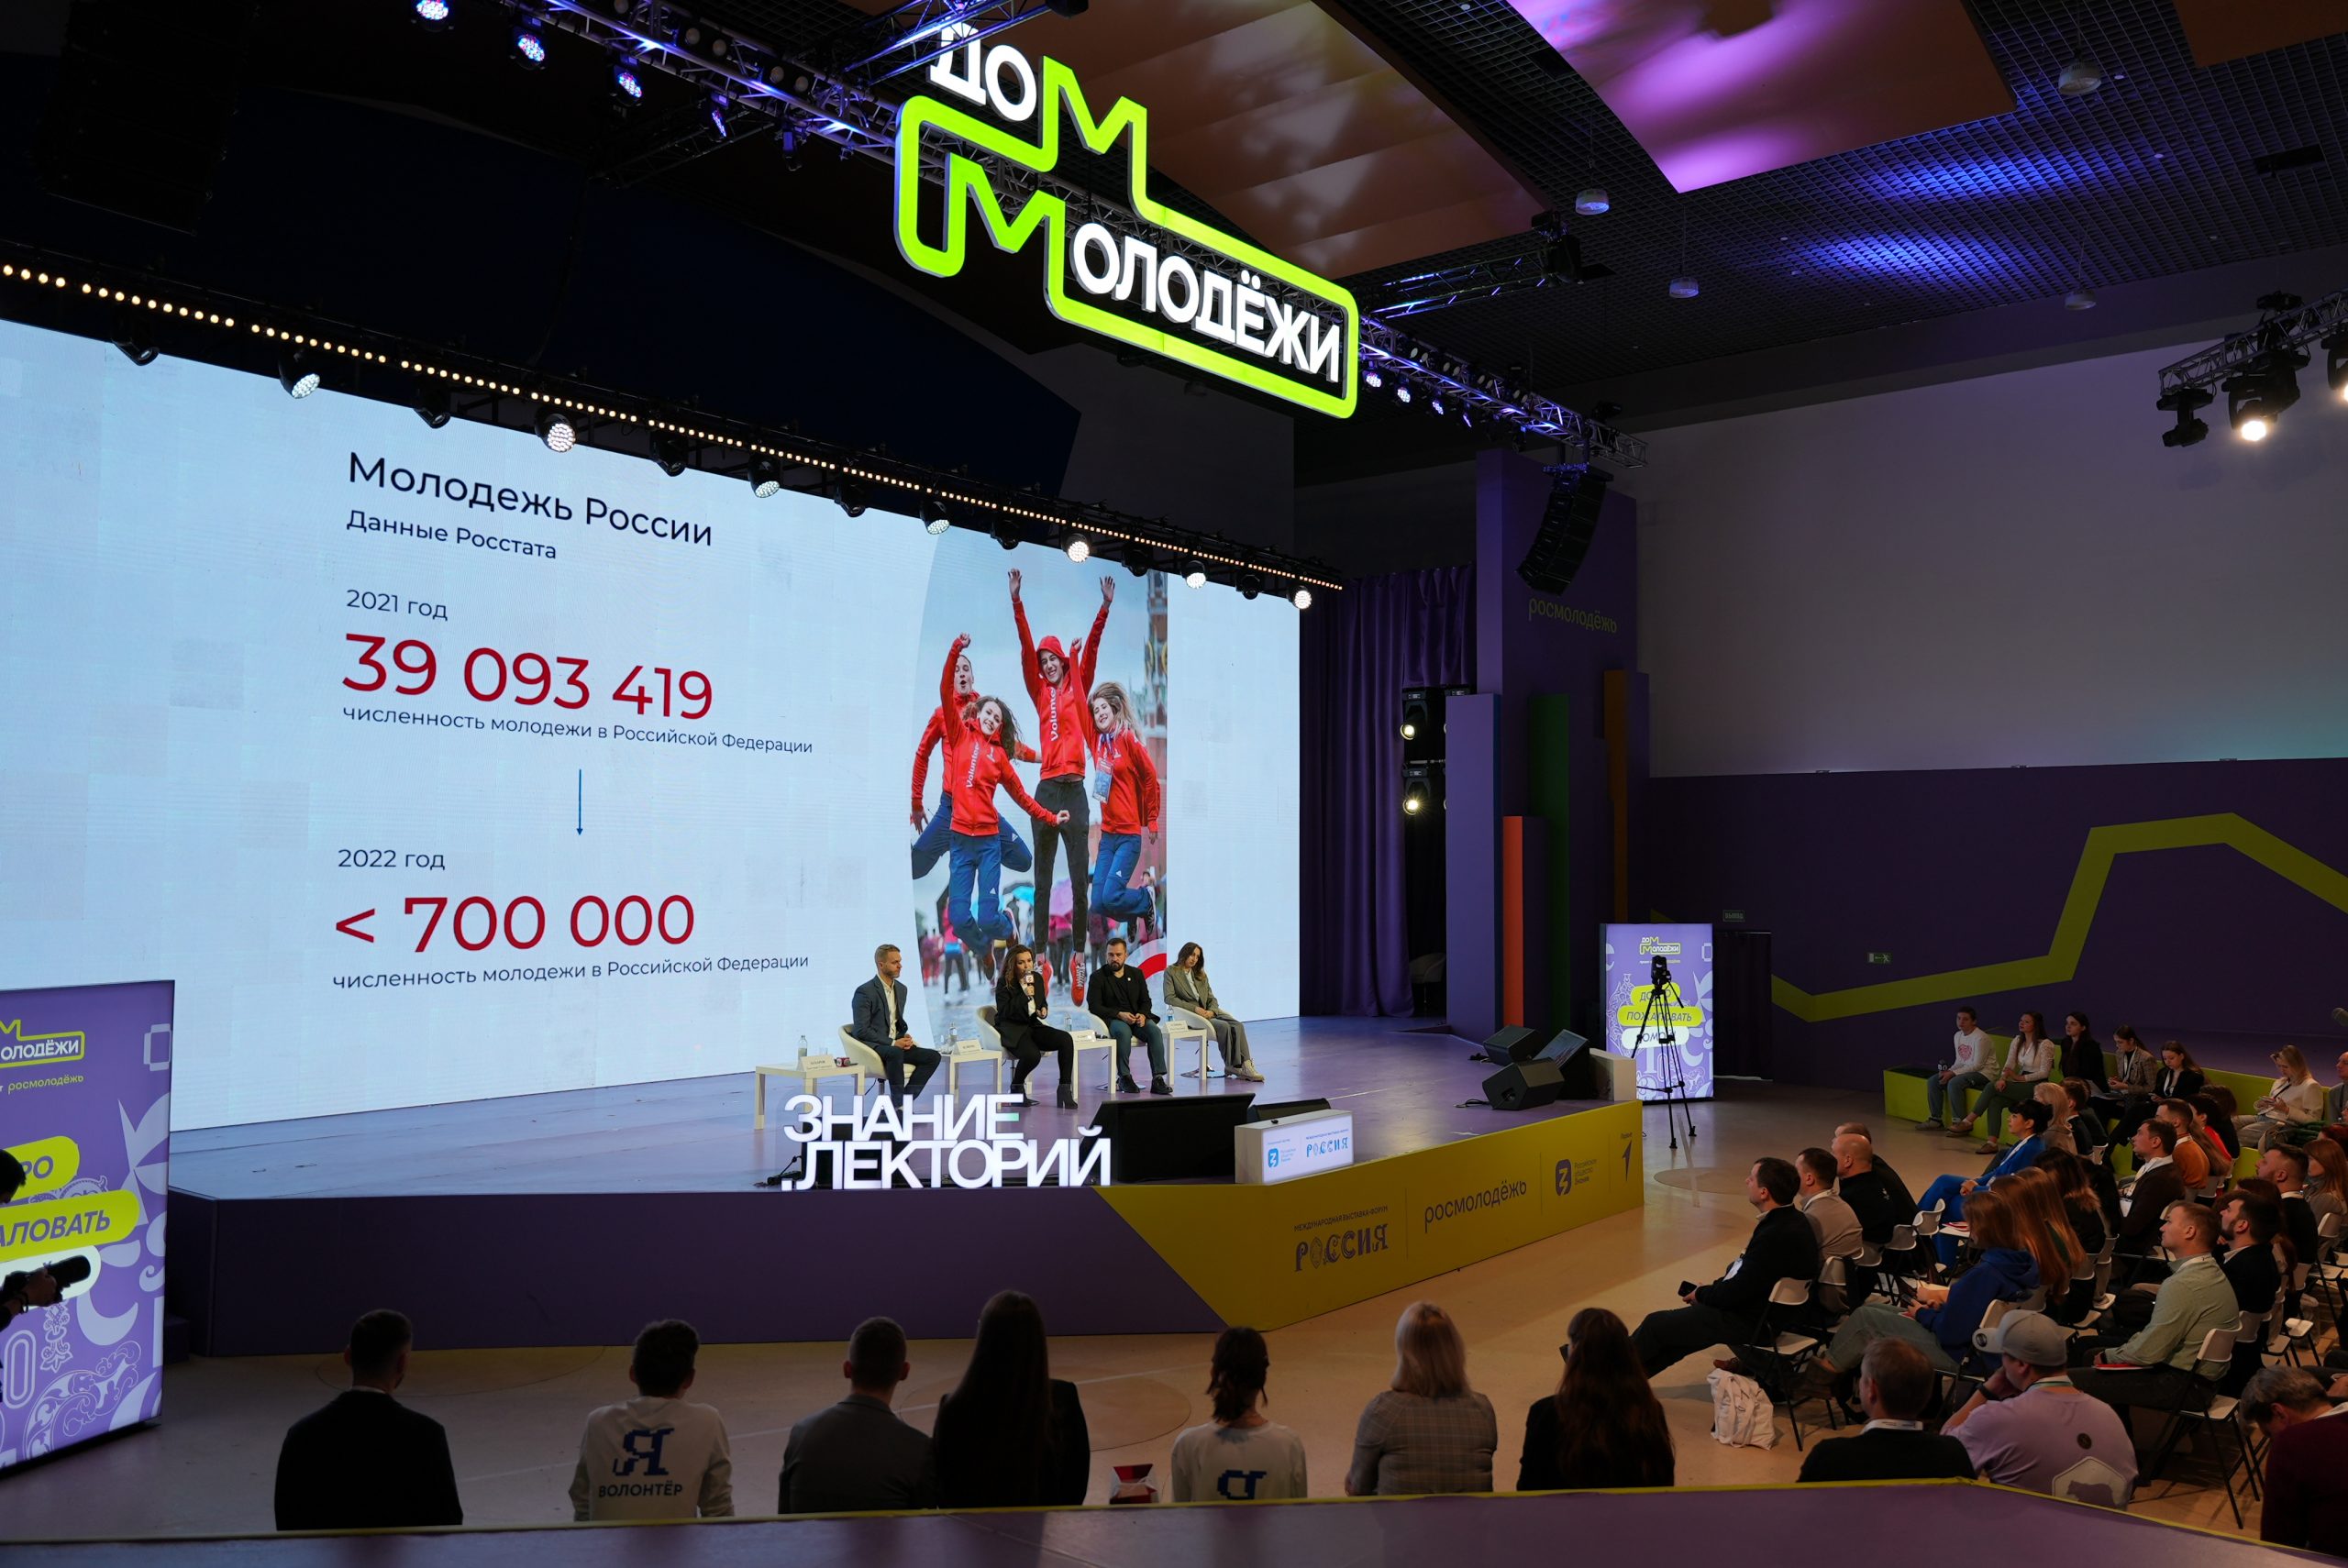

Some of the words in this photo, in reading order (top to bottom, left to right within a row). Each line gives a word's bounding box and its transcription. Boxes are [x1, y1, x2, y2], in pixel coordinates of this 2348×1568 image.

[929, 18, 1147, 171] ДОМ
[946, 152, 1340, 383] МОЛОДЁЖИ
[349, 452, 572, 521] Молодежь
[585, 496, 713, 547] России
[346, 510, 449, 545] Данные
[457, 528, 558, 559] Росстата
[347, 590, 399, 613] 2021
[408, 599, 449, 621] год
[1528, 598, 1617, 634] росмолодёжь
[342, 633, 437, 696] 39
[463, 647, 591, 711] 093
[612, 665, 714, 721] 419
[343, 707, 486, 731] численность
[491, 717, 593, 738] молодежи
[598, 724, 608, 739] в
[614, 724, 717, 747] Российской
[722, 734, 814, 755] Федерации
[338, 849, 397, 868] 2022
[404, 852, 446, 871] год
[335, 908, 376, 944] <
[404, 895, 546, 953] 700
[570, 894, 695, 947] 000
[333, 968, 476, 990] численность
[482, 965, 587, 984] молодежи
[592, 966, 602, 978] в
[607, 955, 714, 977] Российской
[716, 954, 810, 974] Федерации
[7, 1075, 84, 1095] росмолодёжь
[783, 1093, 1024, 1143] ЗНАНИЕ
[1423, 1178, 1528, 1233] росмолодёжь
[1295, 1223, 1389, 1272] РОССИЯ
[612, 1427, 675, 1476] Я
[598, 1480, 682, 1498] ВОЛОНТЁР
